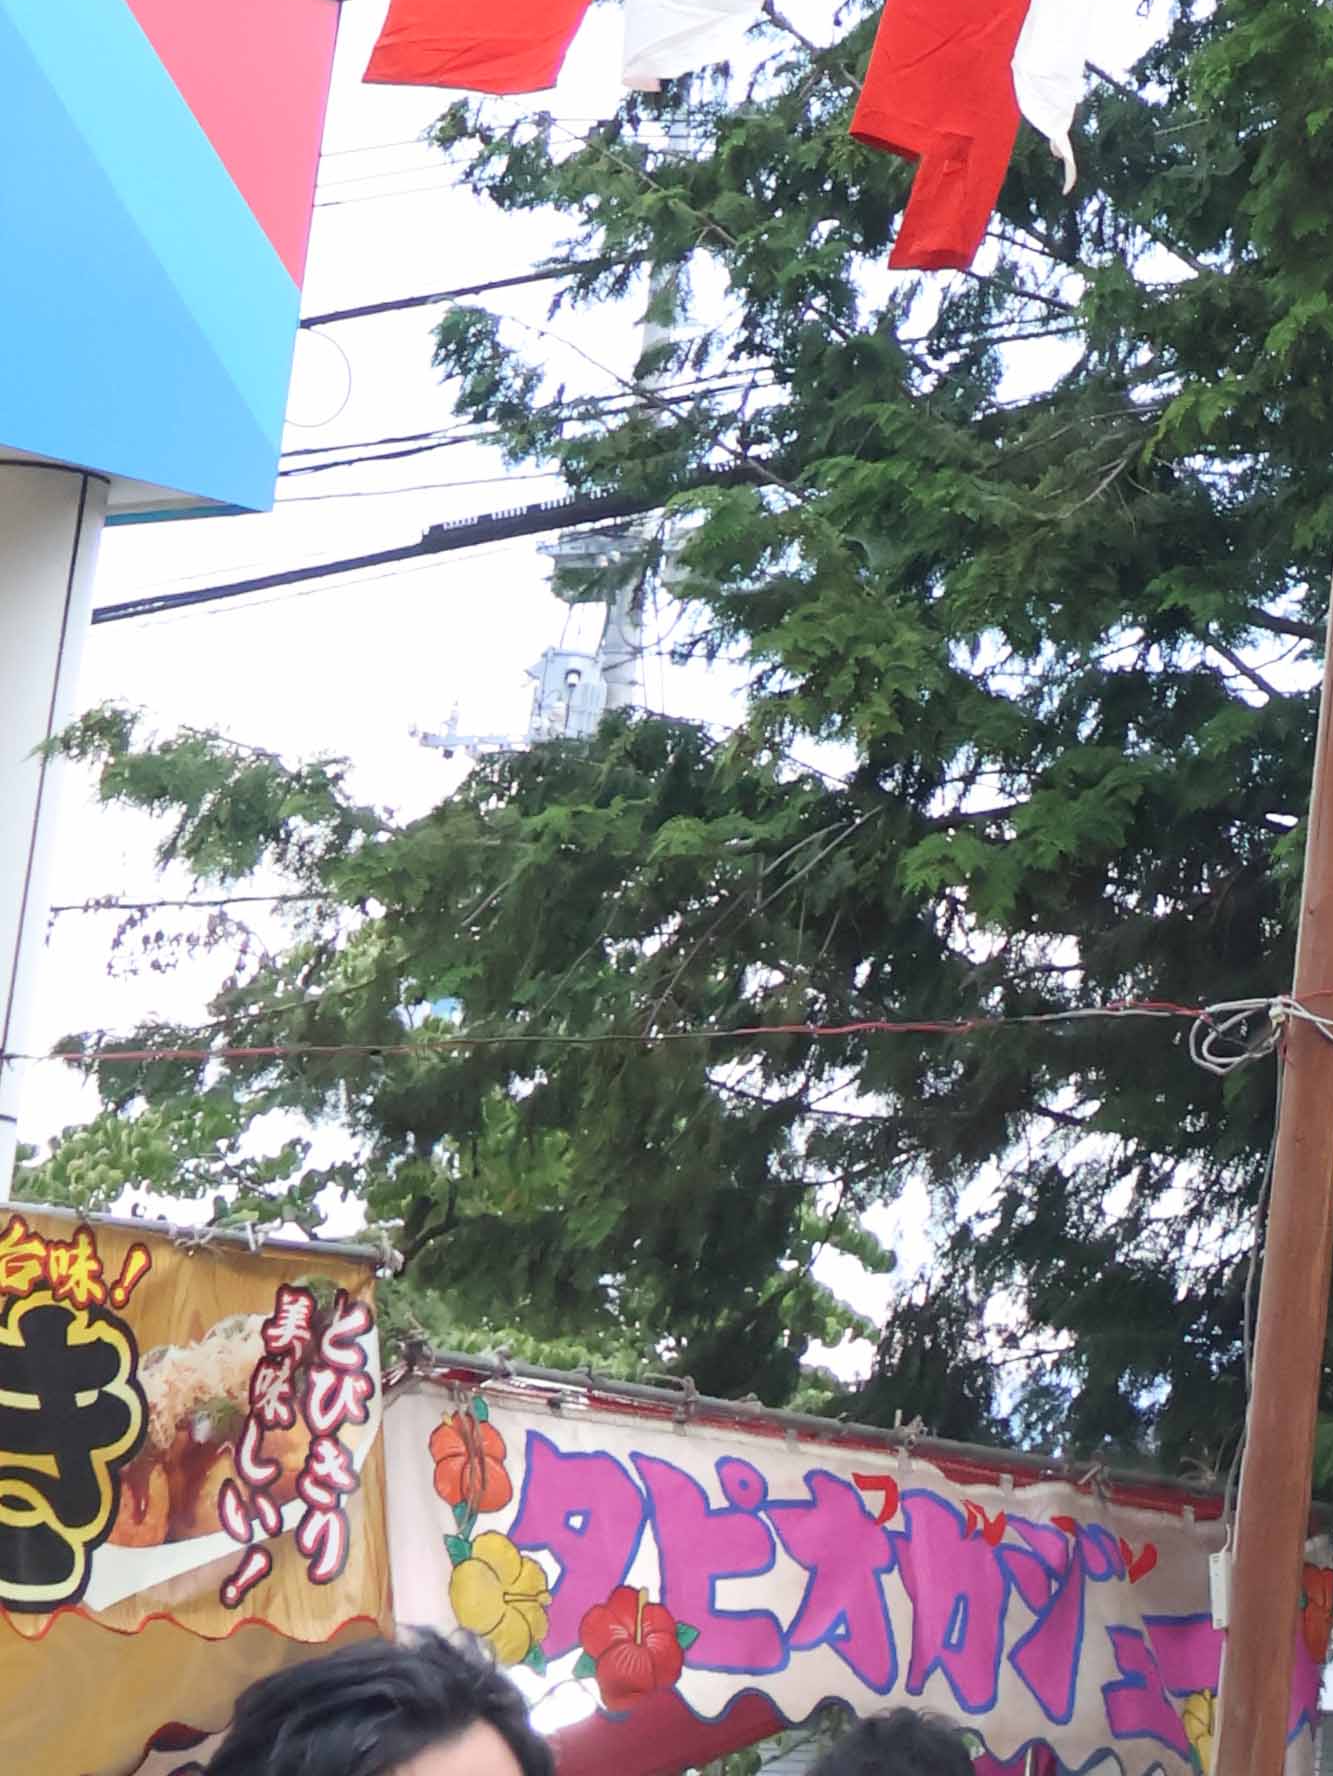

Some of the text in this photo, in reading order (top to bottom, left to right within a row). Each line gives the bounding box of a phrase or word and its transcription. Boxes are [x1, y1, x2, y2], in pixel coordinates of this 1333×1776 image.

[218, 1285, 316, 1608] 美味しい!
[300, 1290, 374, 1584] とびきり
